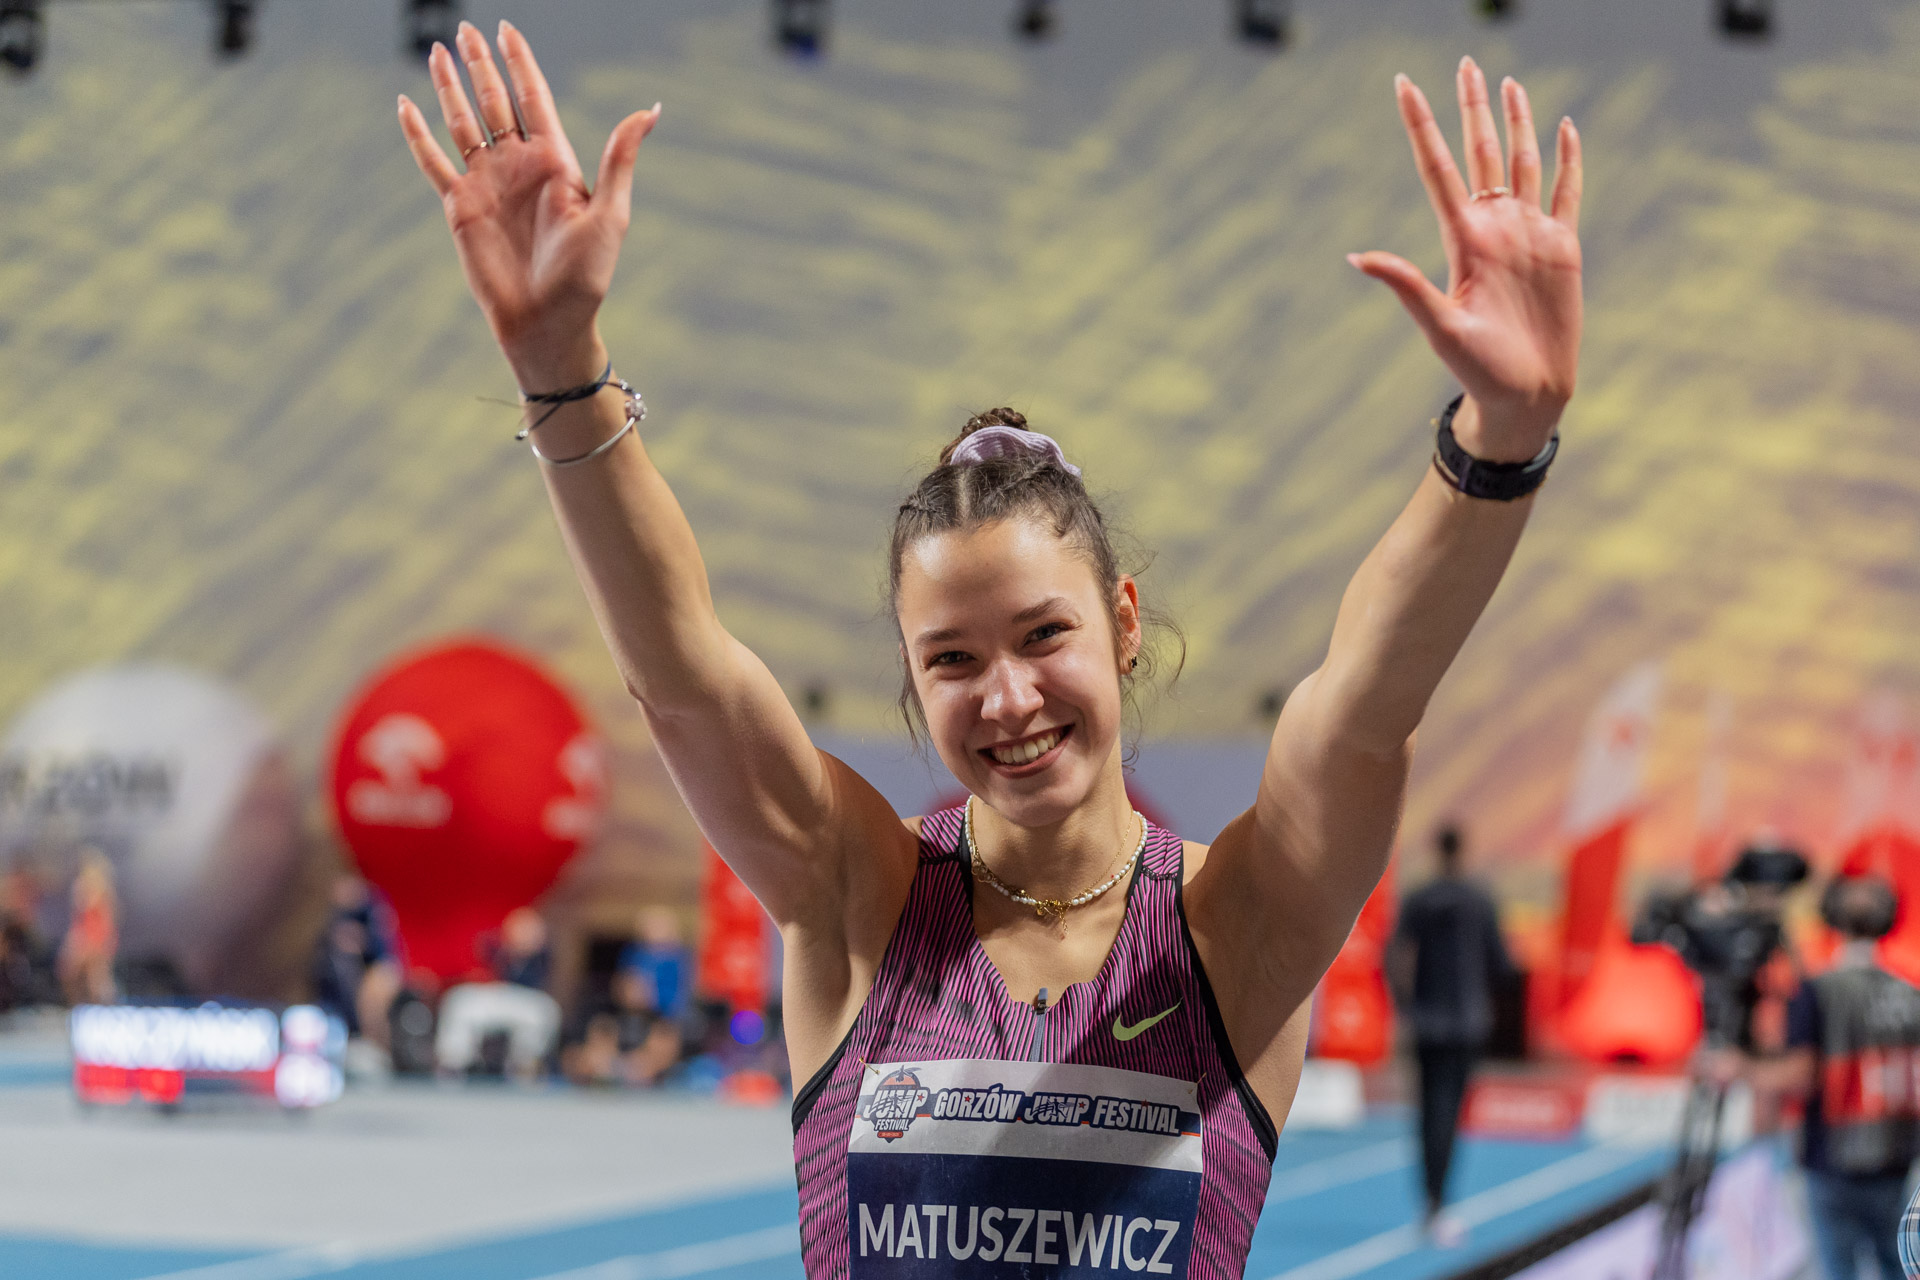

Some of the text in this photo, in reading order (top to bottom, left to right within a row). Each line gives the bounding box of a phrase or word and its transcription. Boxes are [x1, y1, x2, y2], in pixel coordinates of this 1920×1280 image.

[863, 1089, 928, 1118] JUMP
[934, 1086, 1179, 1133] GORZÓW JUMP FESTIVAL
[874, 1119, 909, 1131] FESTIVAL
[858, 1203, 1180, 1274] MATUSZEWICZ
